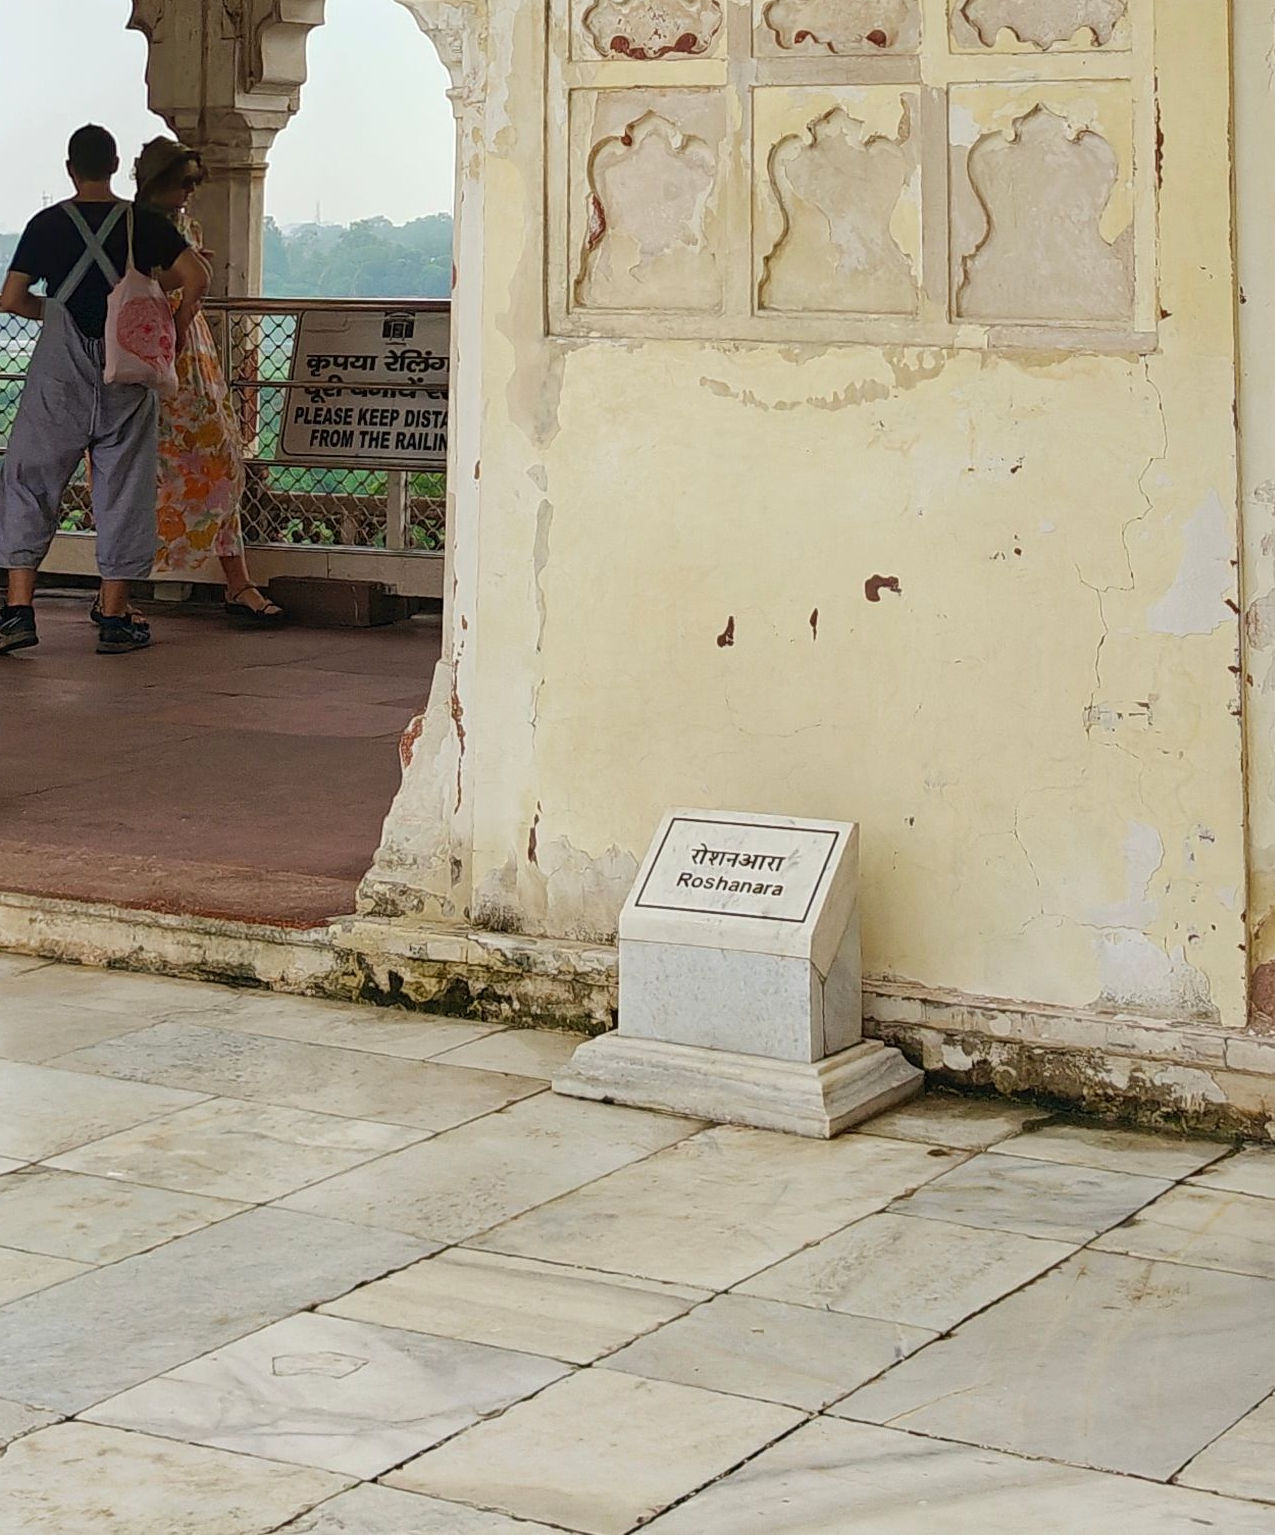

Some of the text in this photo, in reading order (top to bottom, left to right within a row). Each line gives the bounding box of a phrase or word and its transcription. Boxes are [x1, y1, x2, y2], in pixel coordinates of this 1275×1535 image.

[306, 354, 378, 377] कृपया
[294, 406, 449, 430] PLEASE KEEP DISTA
[309, 429, 448, 452] FROM THE RAILIN
[690, 842, 787, 873] रोशनआरा
[676, 871, 784, 897] Roshanara
